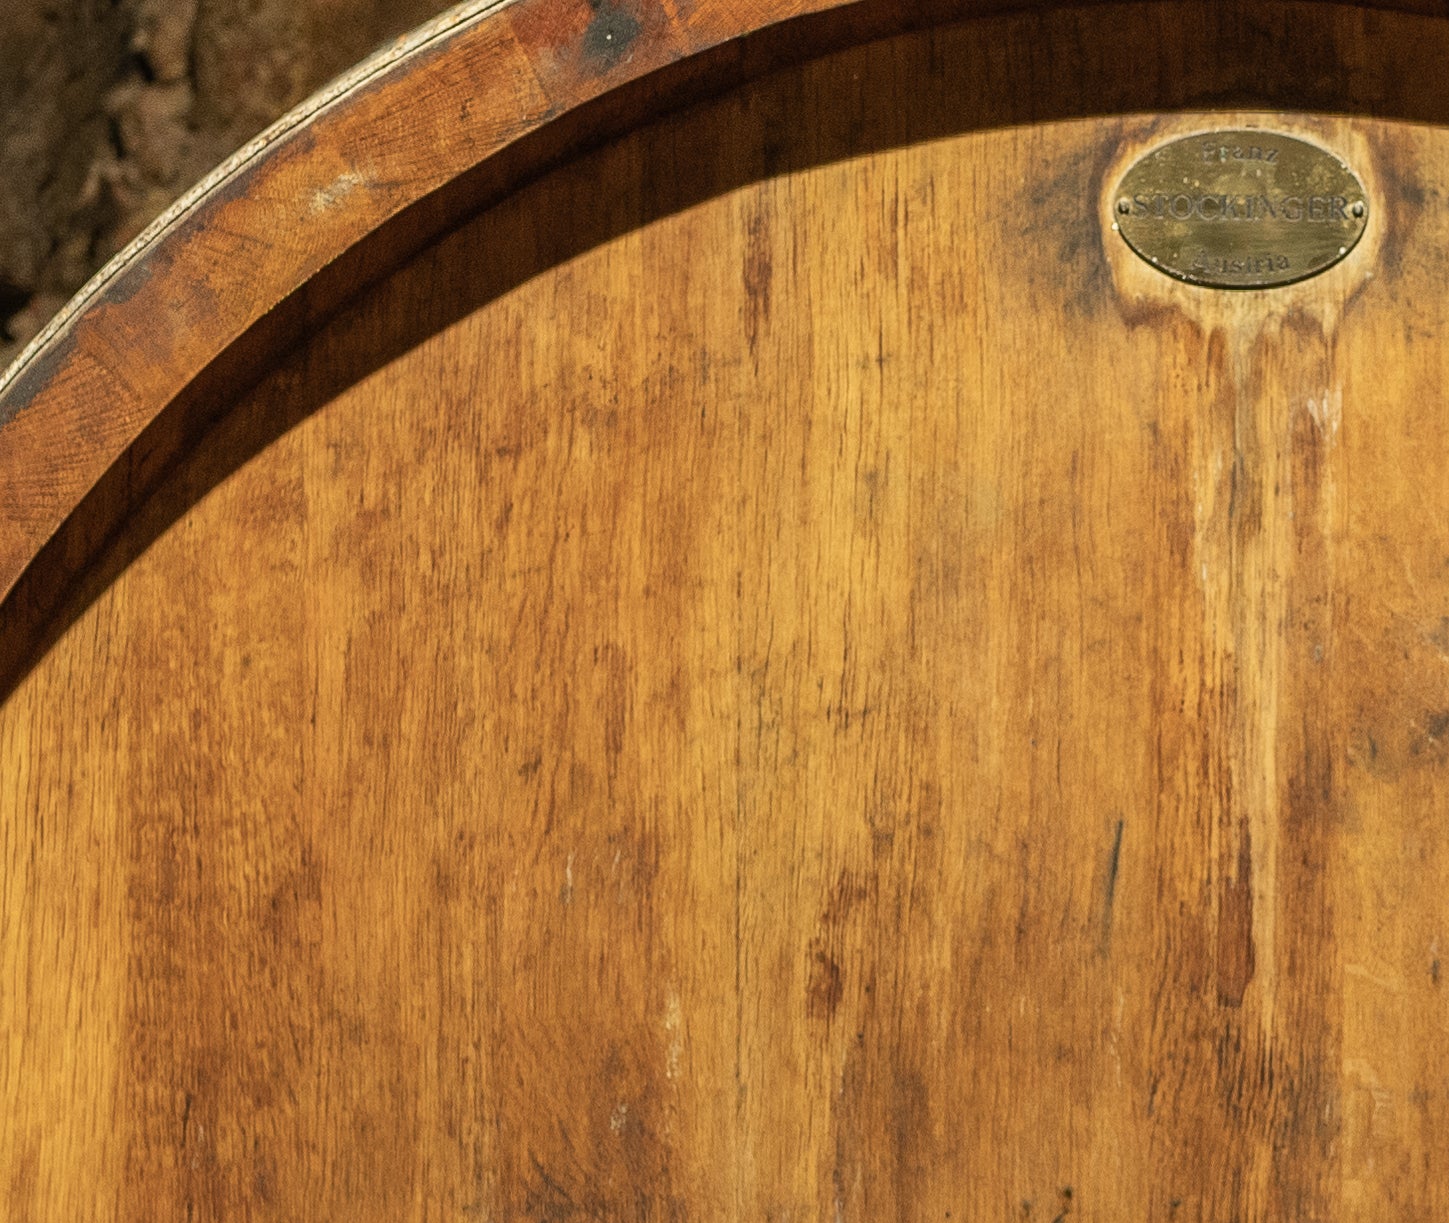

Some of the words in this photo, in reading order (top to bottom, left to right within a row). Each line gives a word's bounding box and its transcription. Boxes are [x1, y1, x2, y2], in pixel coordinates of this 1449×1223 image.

[1201, 141, 1280, 165] Franz
[1132, 193, 1349, 223] STOCKINGER
[1191, 249, 1290, 275] Austria
